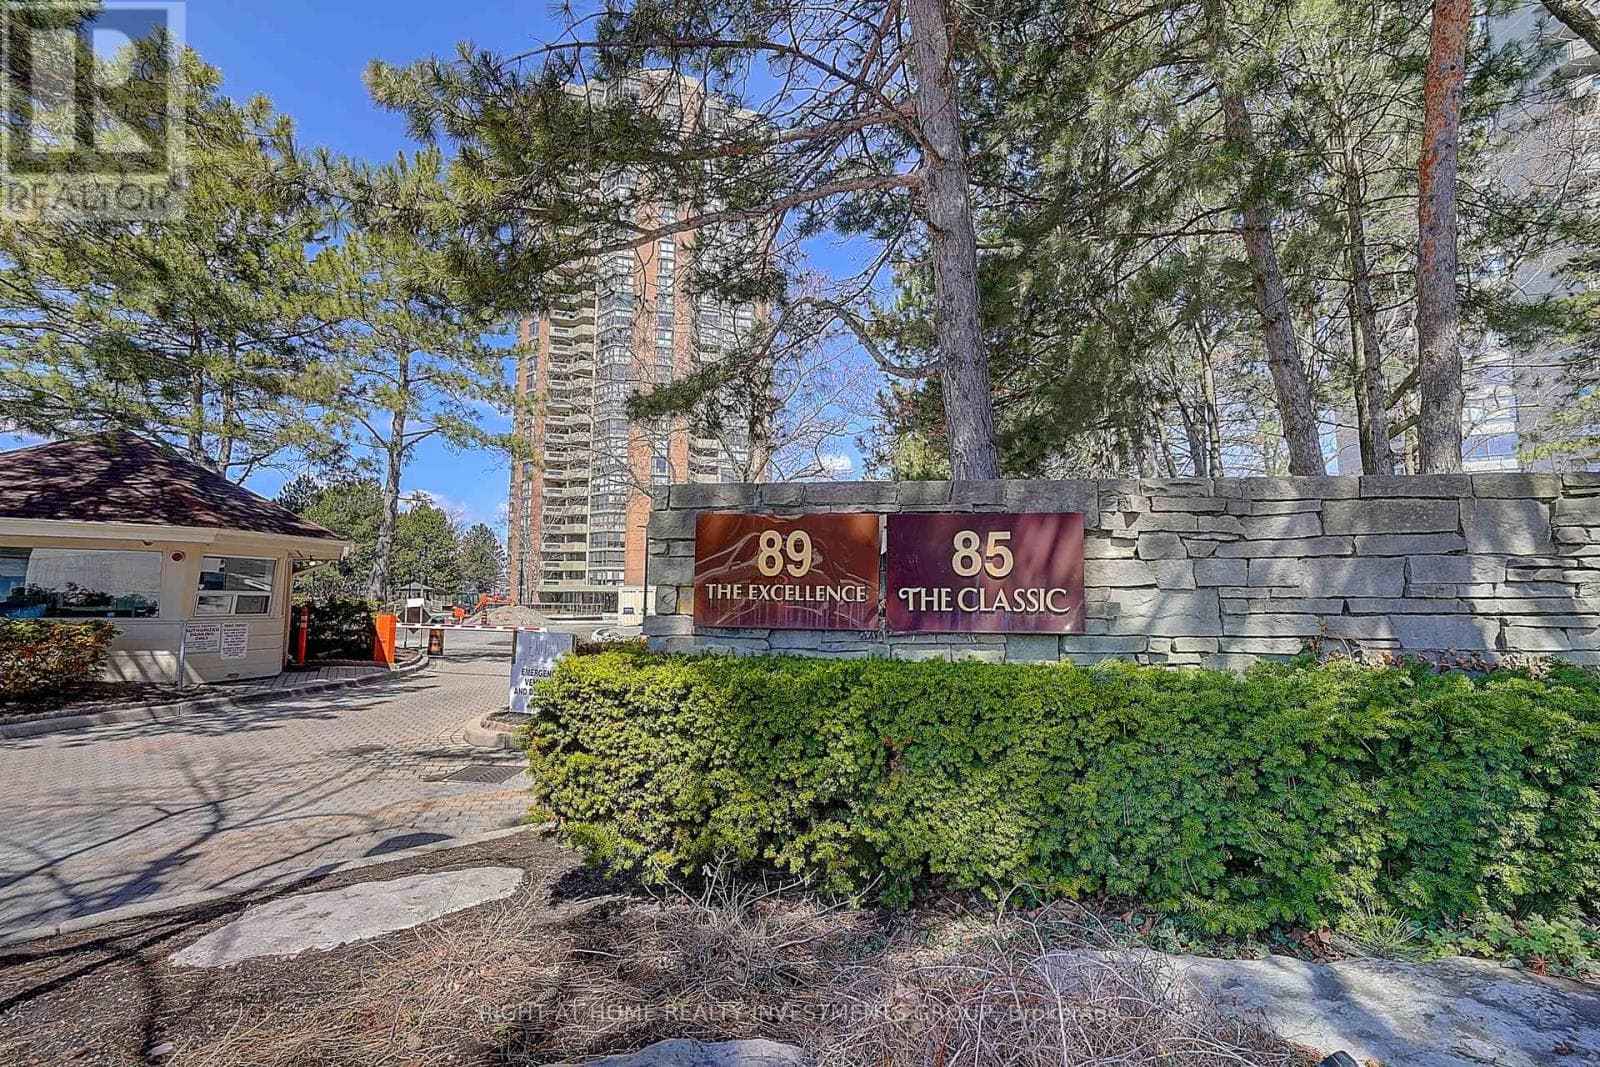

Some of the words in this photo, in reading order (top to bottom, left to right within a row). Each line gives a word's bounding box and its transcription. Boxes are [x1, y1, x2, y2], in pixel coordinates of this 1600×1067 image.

[757, 529, 813, 579] 89
[951, 530, 1014, 579] 85
[705, 583, 742, 601] THE
[748, 584, 868, 603] EXCELLENCE
[898, 587, 953, 613] THE
[957, 588, 1071, 614] CLASSIC
[521, 668, 556, 678] EMERGENC
[514, 687, 527, 696] AND
